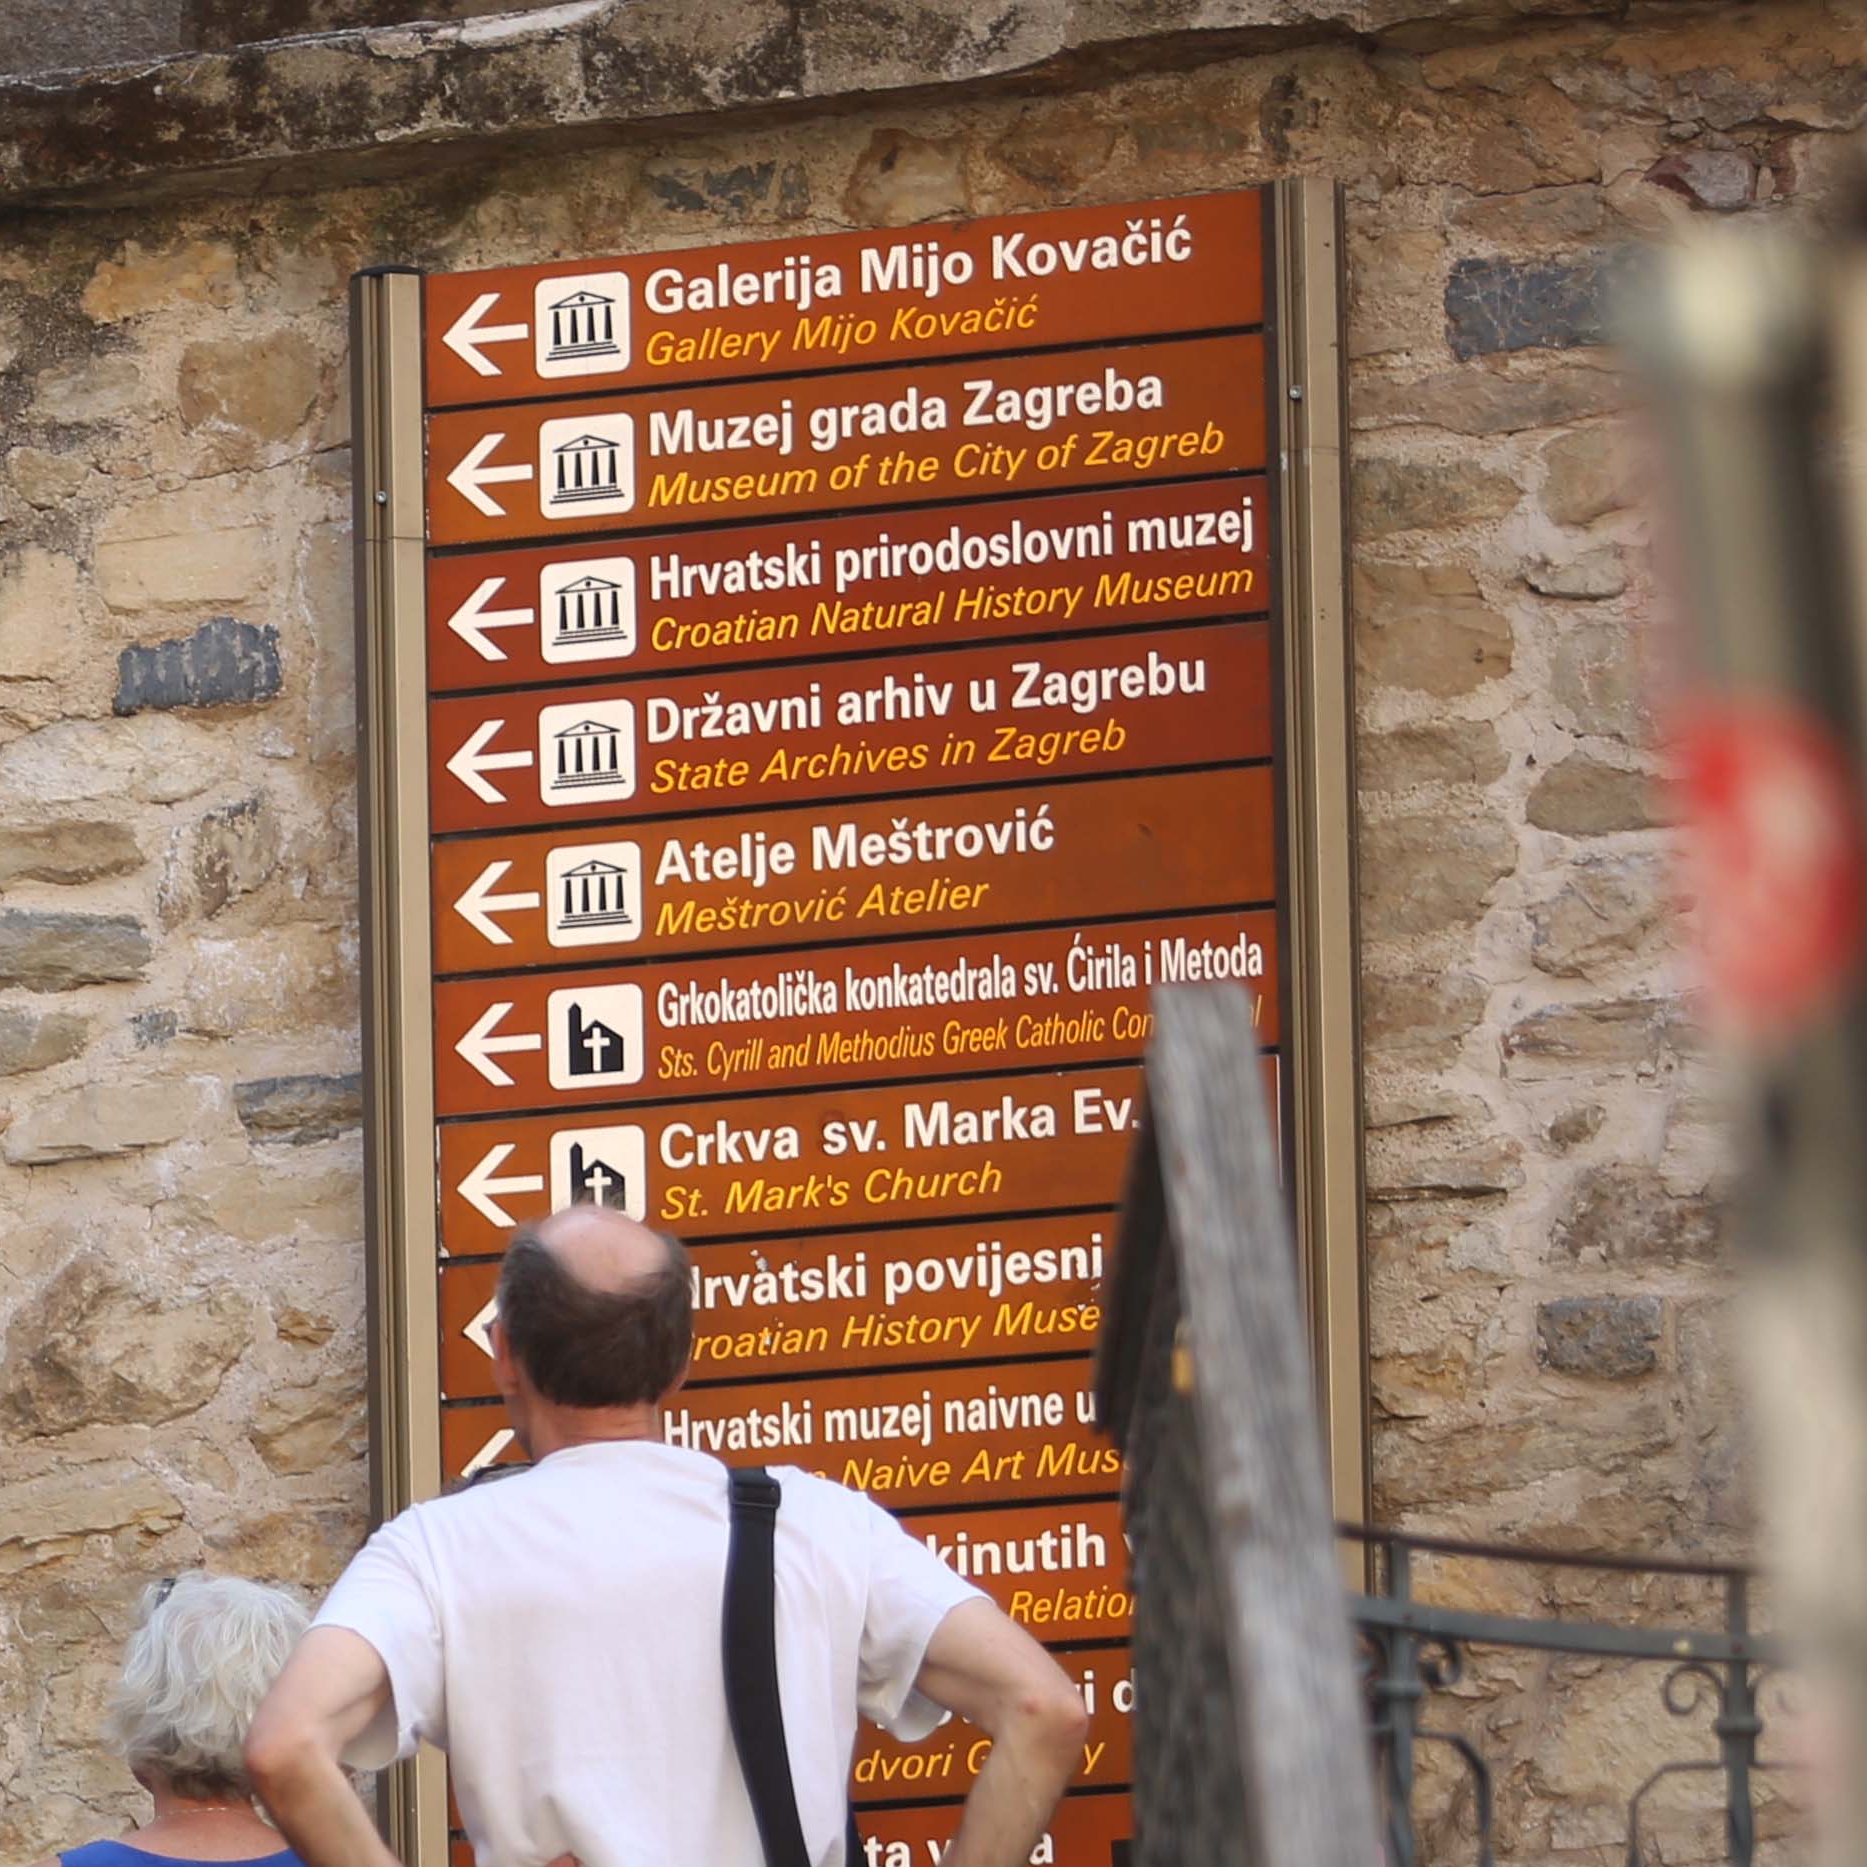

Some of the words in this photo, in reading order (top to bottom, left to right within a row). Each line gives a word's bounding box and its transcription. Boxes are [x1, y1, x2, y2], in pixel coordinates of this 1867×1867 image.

[644, 255, 842, 314] Galerija
[861, 241, 974, 298] Mijo
[992, 214, 1191, 280] Kovačić
[645, 326, 782, 366] Gallery
[792, 313, 877, 354] Mijo
[889, 293, 1038, 341] Kovačić
[649, 400, 793, 457] Muzej
[809, 387, 947, 448] grada
[963, 367, 1163, 430] Zagreba
[647, 468, 818, 508] Museum
[829, 453, 872, 491] of
[878, 450, 939, 486] the
[953, 442, 1028, 481] City
[1036, 434, 1078, 471] of
[1084, 420, 1224, 469] Zagreb
[650, 540, 821, 600] Hrvatski
[835, 511, 1113, 593] prirodoslovni
[1128, 496, 1253, 553] muzej
[651, 609, 799, 652] Croatian
[810, 600, 946, 637] Natural
[953, 585, 1083, 622] History
[1093, 569, 1253, 608] Museum
[647, 683, 821, 743] Državni
[837, 672, 953, 726] arhiv
[969, 679, 996, 713] u
[1011, 651, 1205, 714] Zagrebu
[650, 758, 750, 794] State
[759, 740, 929, 783] Archives
[940, 733, 976, 766] in
[987, 718, 1126, 765] Zagreb
[655, 831, 796, 888] Atelje
[812, 804, 1054, 871] Meštrović
[654, 887, 847, 937] Meštrović
[856, 877, 990, 919] Atelier
[657, 970, 838, 1028] Grkokatolička
[845, 954, 1017, 1012] konkatedrala
[1024, 962, 1059, 996] sv.
[1067, 932, 1137, 992] Ćirila
[1144, 940, 1152, 985] i
[1160, 932, 1263, 984] Metoda
[657, 1045, 698, 1079] Sts.
[707, 1037, 764, 1082] Cyrill
[767, 1033, 812, 1070] and
[816, 1024, 936, 1065] Methodius
[942, 1018, 1009, 1055] Greek
[1015, 1011, 1106, 1049] Catholic
[660, 1119, 799, 1169] Crkva
[823, 1119, 886, 1155] sv.
[904, 1095, 1056, 1149] Marka
[1074, 1088, 1139, 1134] Ev.
[660, 1185, 709, 1220] St.
[724, 1174, 851, 1215] Mark's
[864, 1160, 1003, 1202] Church
[884, 1232, 1103, 1301] povijesni
[693, 1321, 828, 1361] roatian
[841, 1313, 983, 1349] History
[992, 1301, 1101, 1337] Muse
[663, 1399, 812, 1450] Hrvatski
[824, 1390, 932, 1447] muzej
[944, 1385, 1064, 1434] naivne
[840, 1455, 952, 1491] Naive
[961, 1449, 1026, 1484] Art
[926, 1523, 1106, 1576] kinutih
[1008, 1585, 1134, 1624] Relatio
[854, 1743, 955, 1783] dvori
